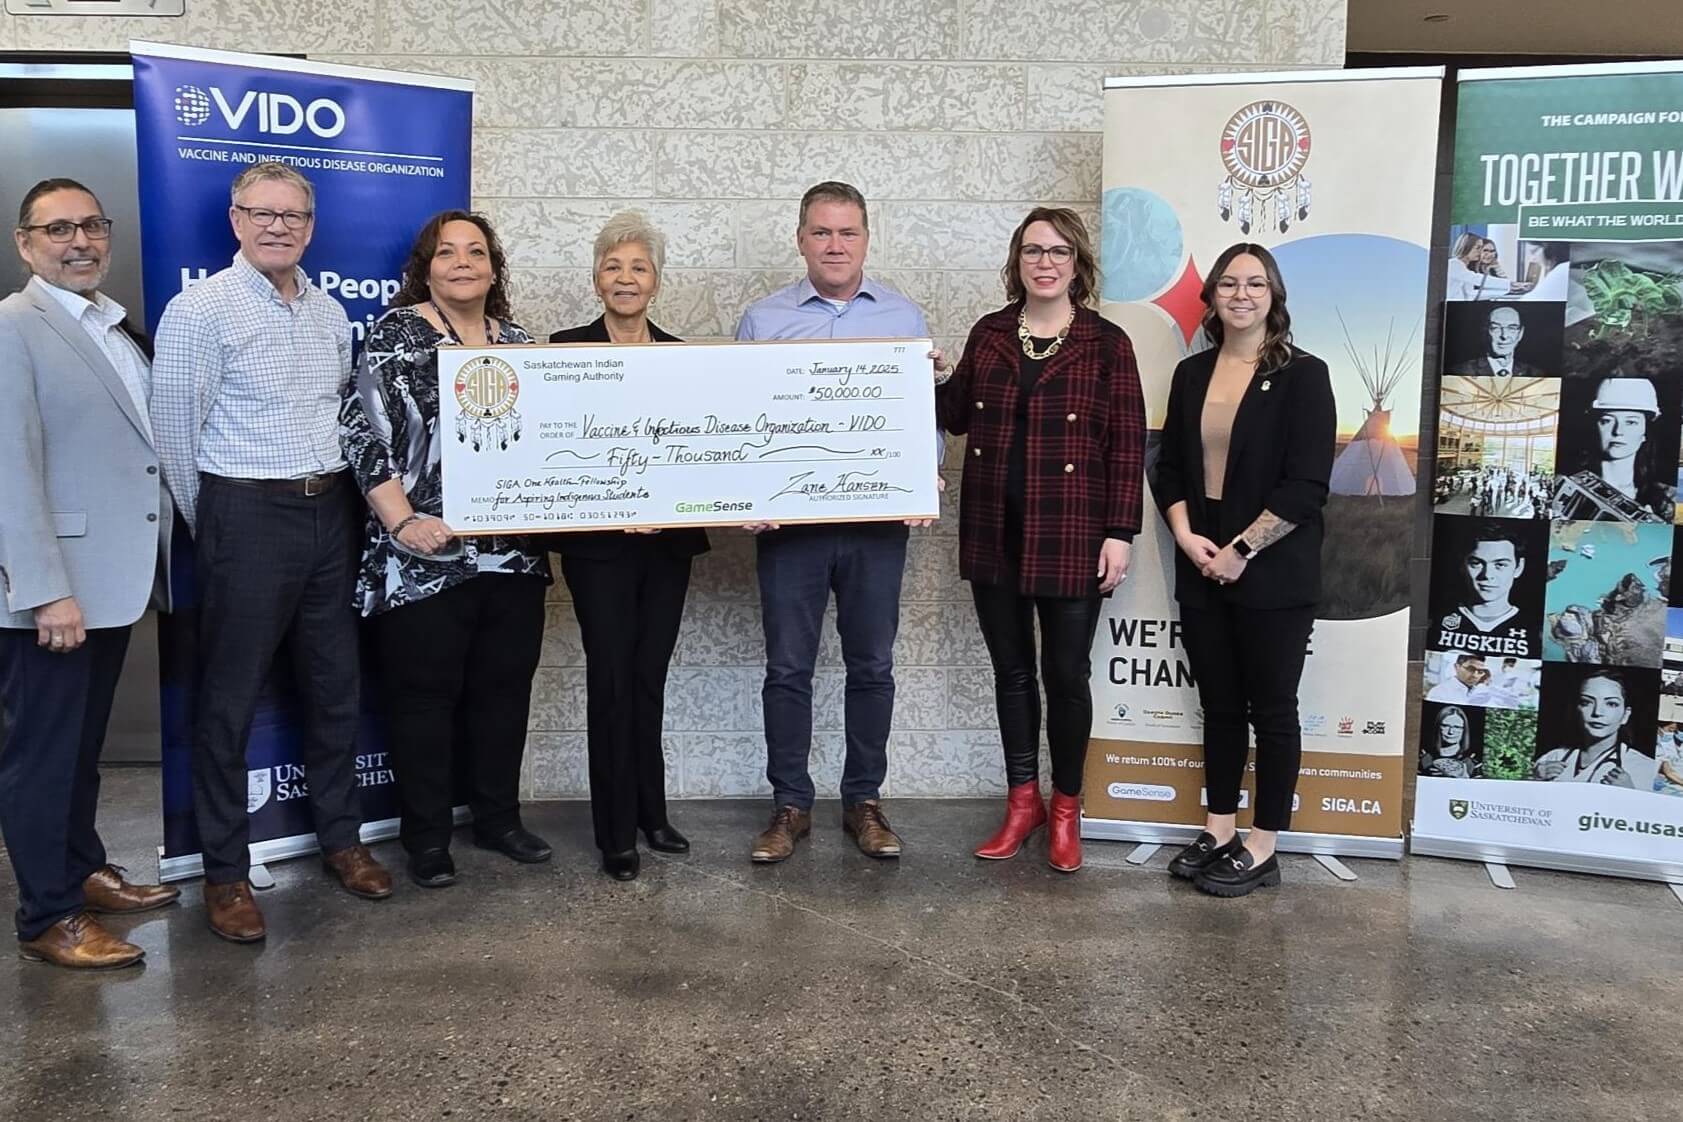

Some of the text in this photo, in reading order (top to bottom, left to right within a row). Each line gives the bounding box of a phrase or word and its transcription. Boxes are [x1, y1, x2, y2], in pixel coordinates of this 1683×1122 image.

[209, 86, 346, 139] VIDO
[1541, 115, 1571, 127] THE
[1574, 112, 1655, 126] CAMPAIGN
[1237, 115, 1295, 172] SIGA
[178, 148, 229, 162] VACCINE
[231, 151, 255, 163] AND
[323, 158, 366, 173] DISEASE
[368, 162, 444, 178] ORGANIZATION
[1480, 151, 1642, 206] TOGETHER
[1528, 217, 1550, 227] BE
[1552, 215, 1596, 227] WHAT
[1597, 215, 1626, 226] THE
[523, 359, 624, 370] Saskatchewan Indian
[543, 371, 624, 383] Gaming Authority
[809, 362, 852, 386] January
[808, 386, 882, 401] $50,000.00
[539, 431, 564, 439] ORDER
[582, 413, 631, 439] Vaccine
[704, 414, 752, 434] Disease
[755, 413, 833, 444] Organization
[850, 414, 886, 430] VIDO
[495, 479, 521, 489] SIGA
[524, 478, 541, 488] One
[809, 493, 889, 503] AUTHORIZED SIGNATURE
[675, 500, 753, 513] GameSense
[1438, 630, 1529, 656] HUSKIES
[1109, 656, 1196, 688] CHAN
[1105, 753, 1120, 764] We
[1121, 755, 1150, 766] return
[1151, 756, 1176, 768] 100%
[1178, 758, 1188, 768] of
[1319, 767, 1383, 780] communities
[1112, 785, 1172, 799] GameSense
[1321, 797, 1382, 815] SIGA.CA
[1471, 800, 1552, 818] UNIVERSITY OF
[1470, 809, 1552, 827] SASKATCHEWAN
